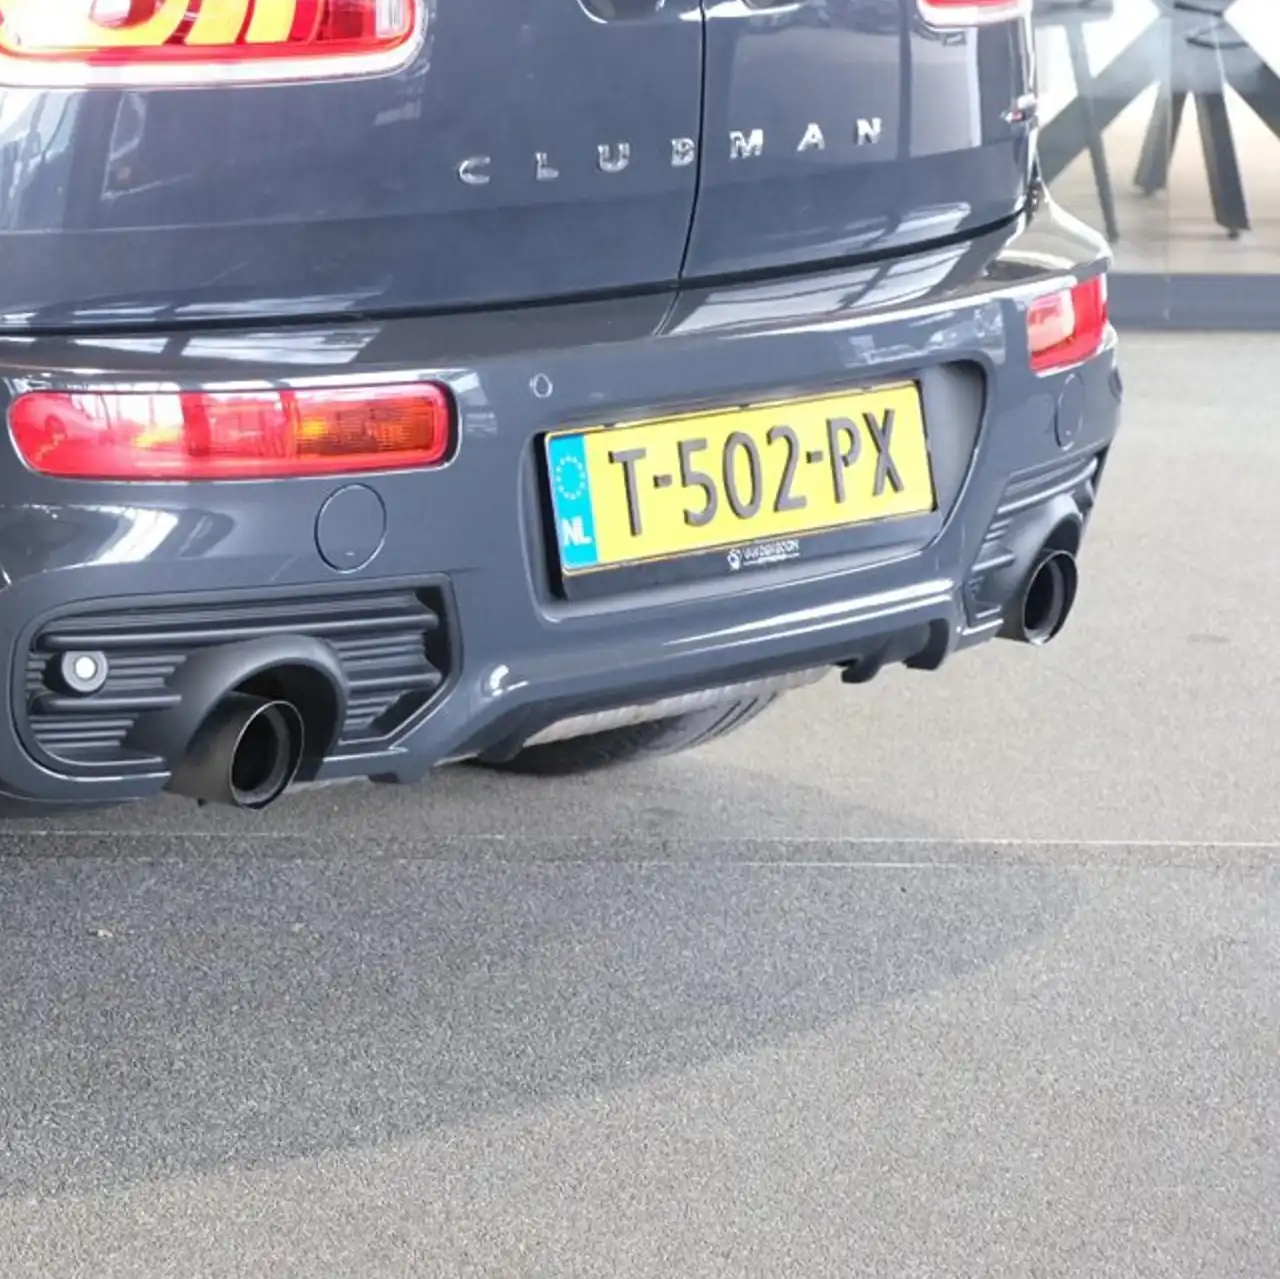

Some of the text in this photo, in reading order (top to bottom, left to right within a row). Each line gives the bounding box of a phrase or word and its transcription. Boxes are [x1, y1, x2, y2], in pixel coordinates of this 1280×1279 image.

[457, 118, 883, 185] CLUBMAN
[608, 408, 905, 537] T-502-PX
[561, 516, 593, 546] NL
